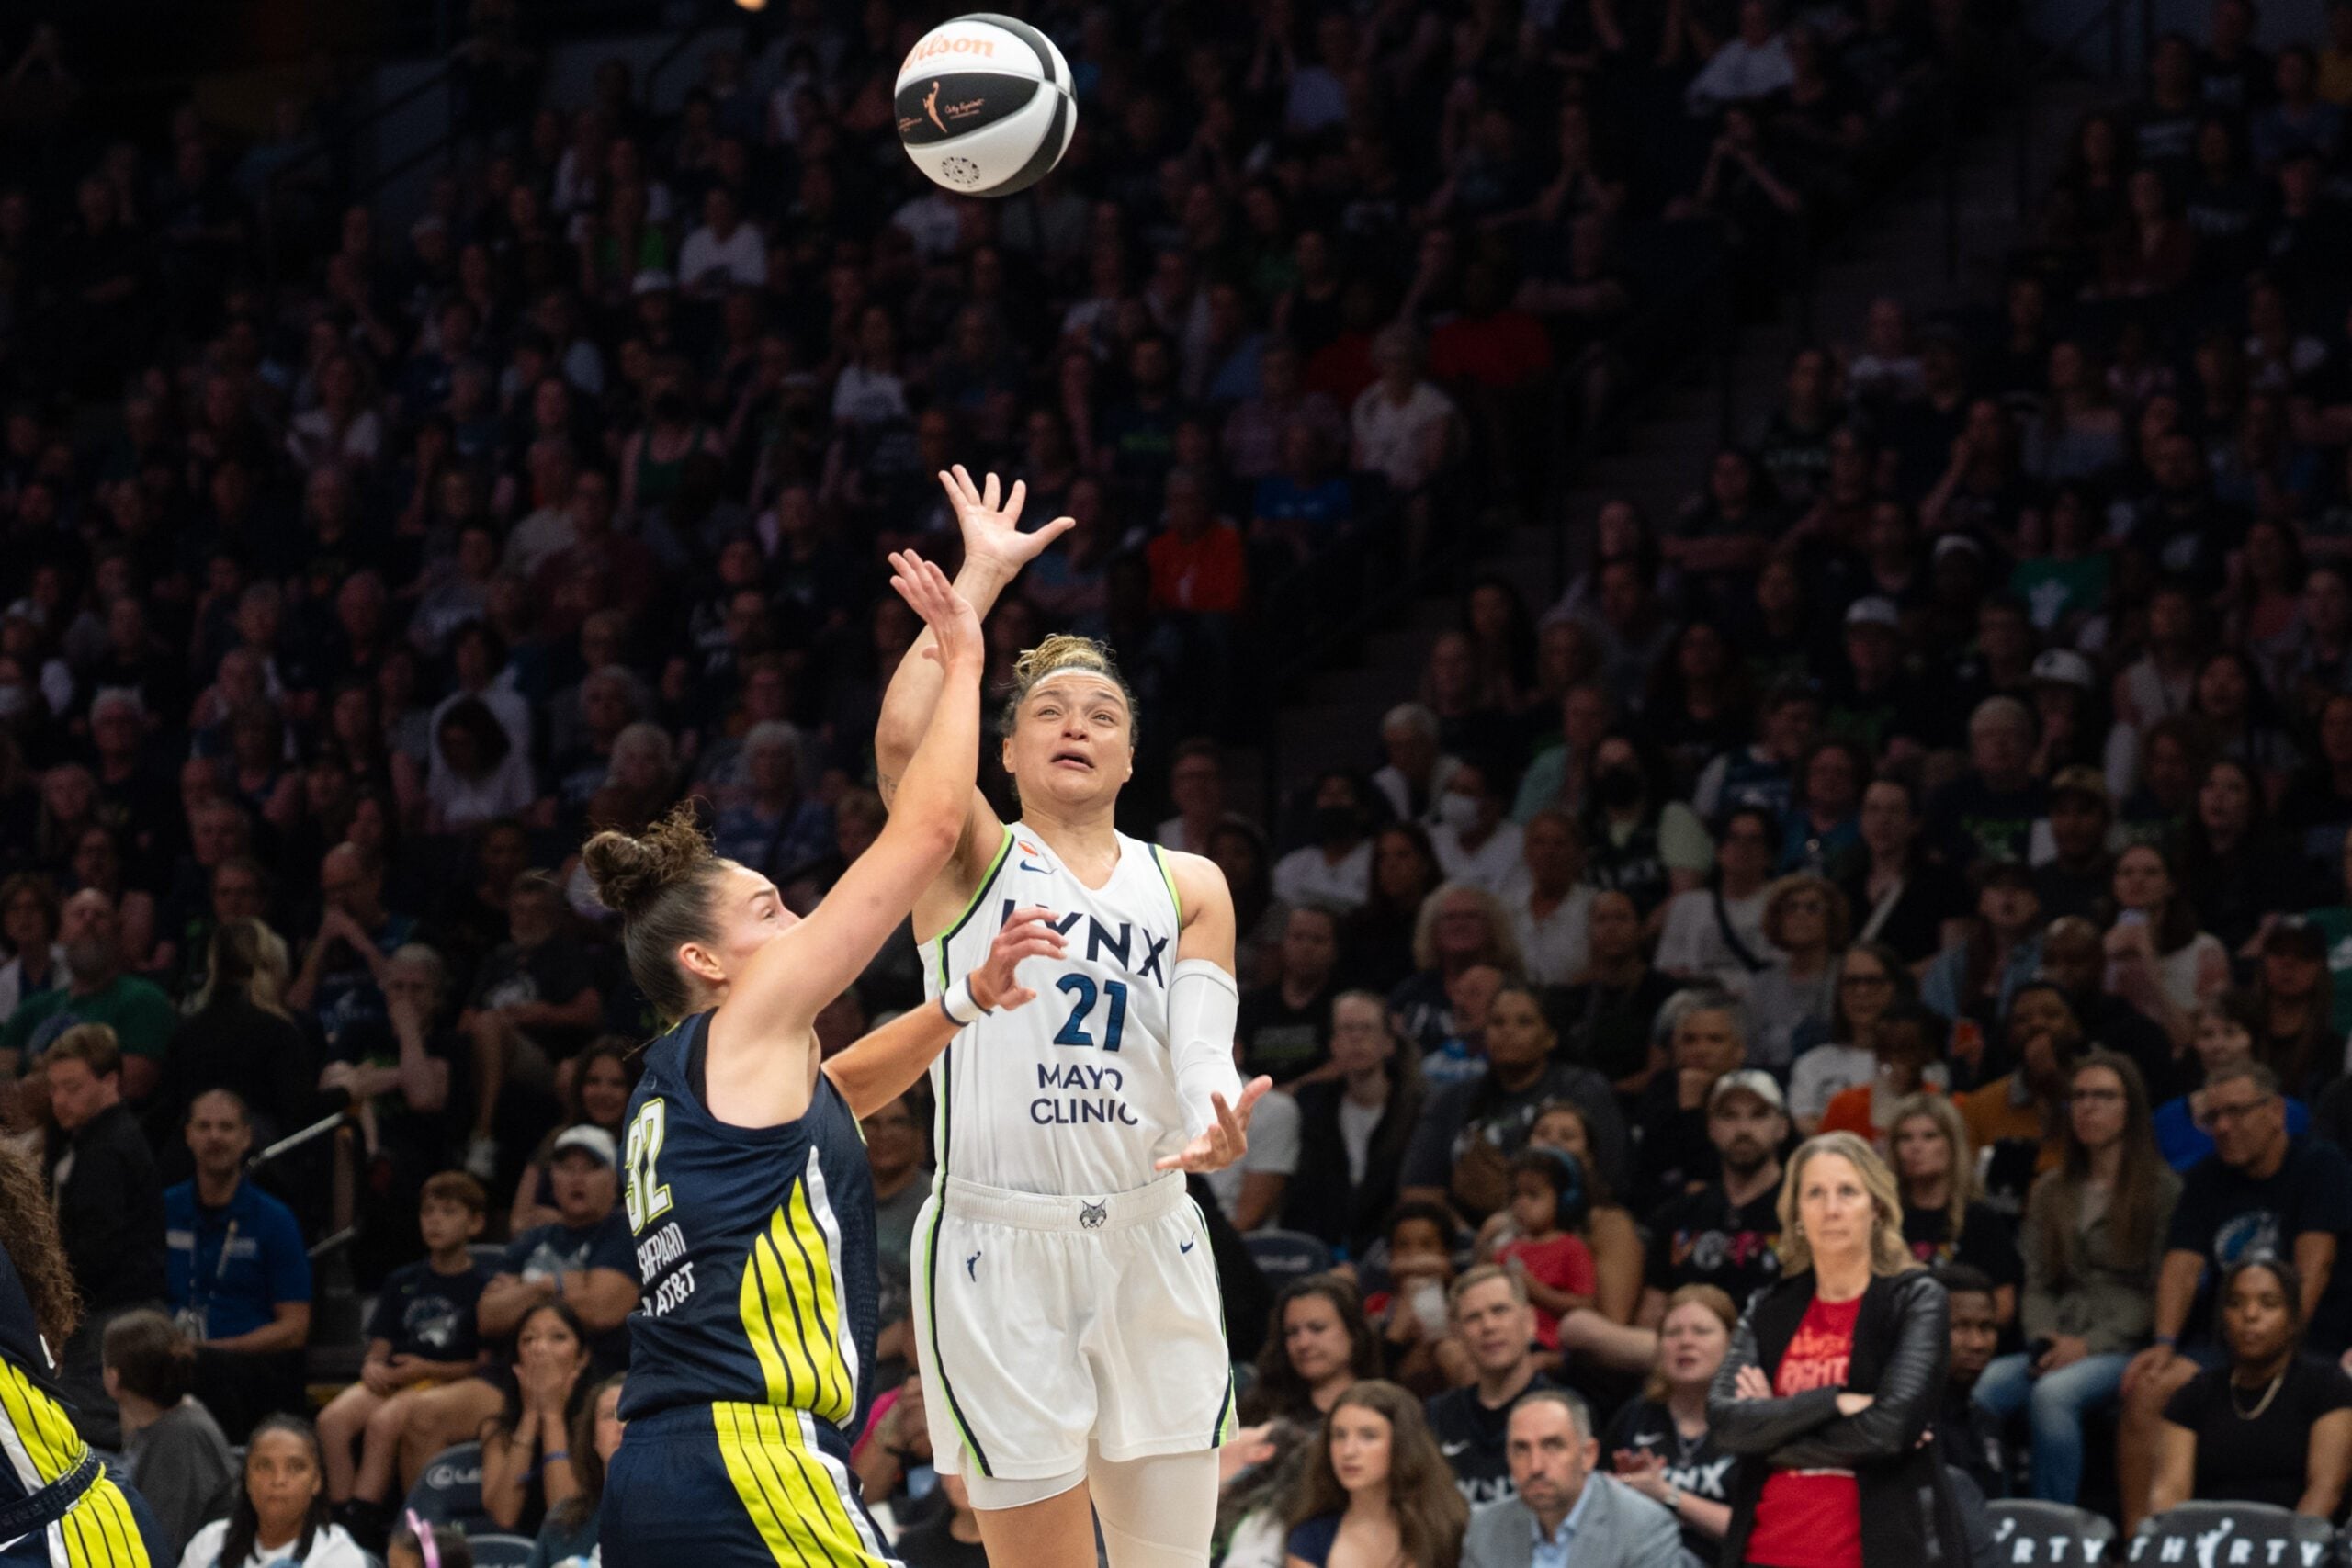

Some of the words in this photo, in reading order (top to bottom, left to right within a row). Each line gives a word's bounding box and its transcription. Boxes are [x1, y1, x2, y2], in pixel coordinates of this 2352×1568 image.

[1053, 973, 1127, 1052] 21
[1037, 1063, 1124, 1092] MAYO
[1030, 1098, 1138, 1126] CLINIC
[624, 1097, 673, 1237] 32
[656, 1261, 695, 1317] AT&T
